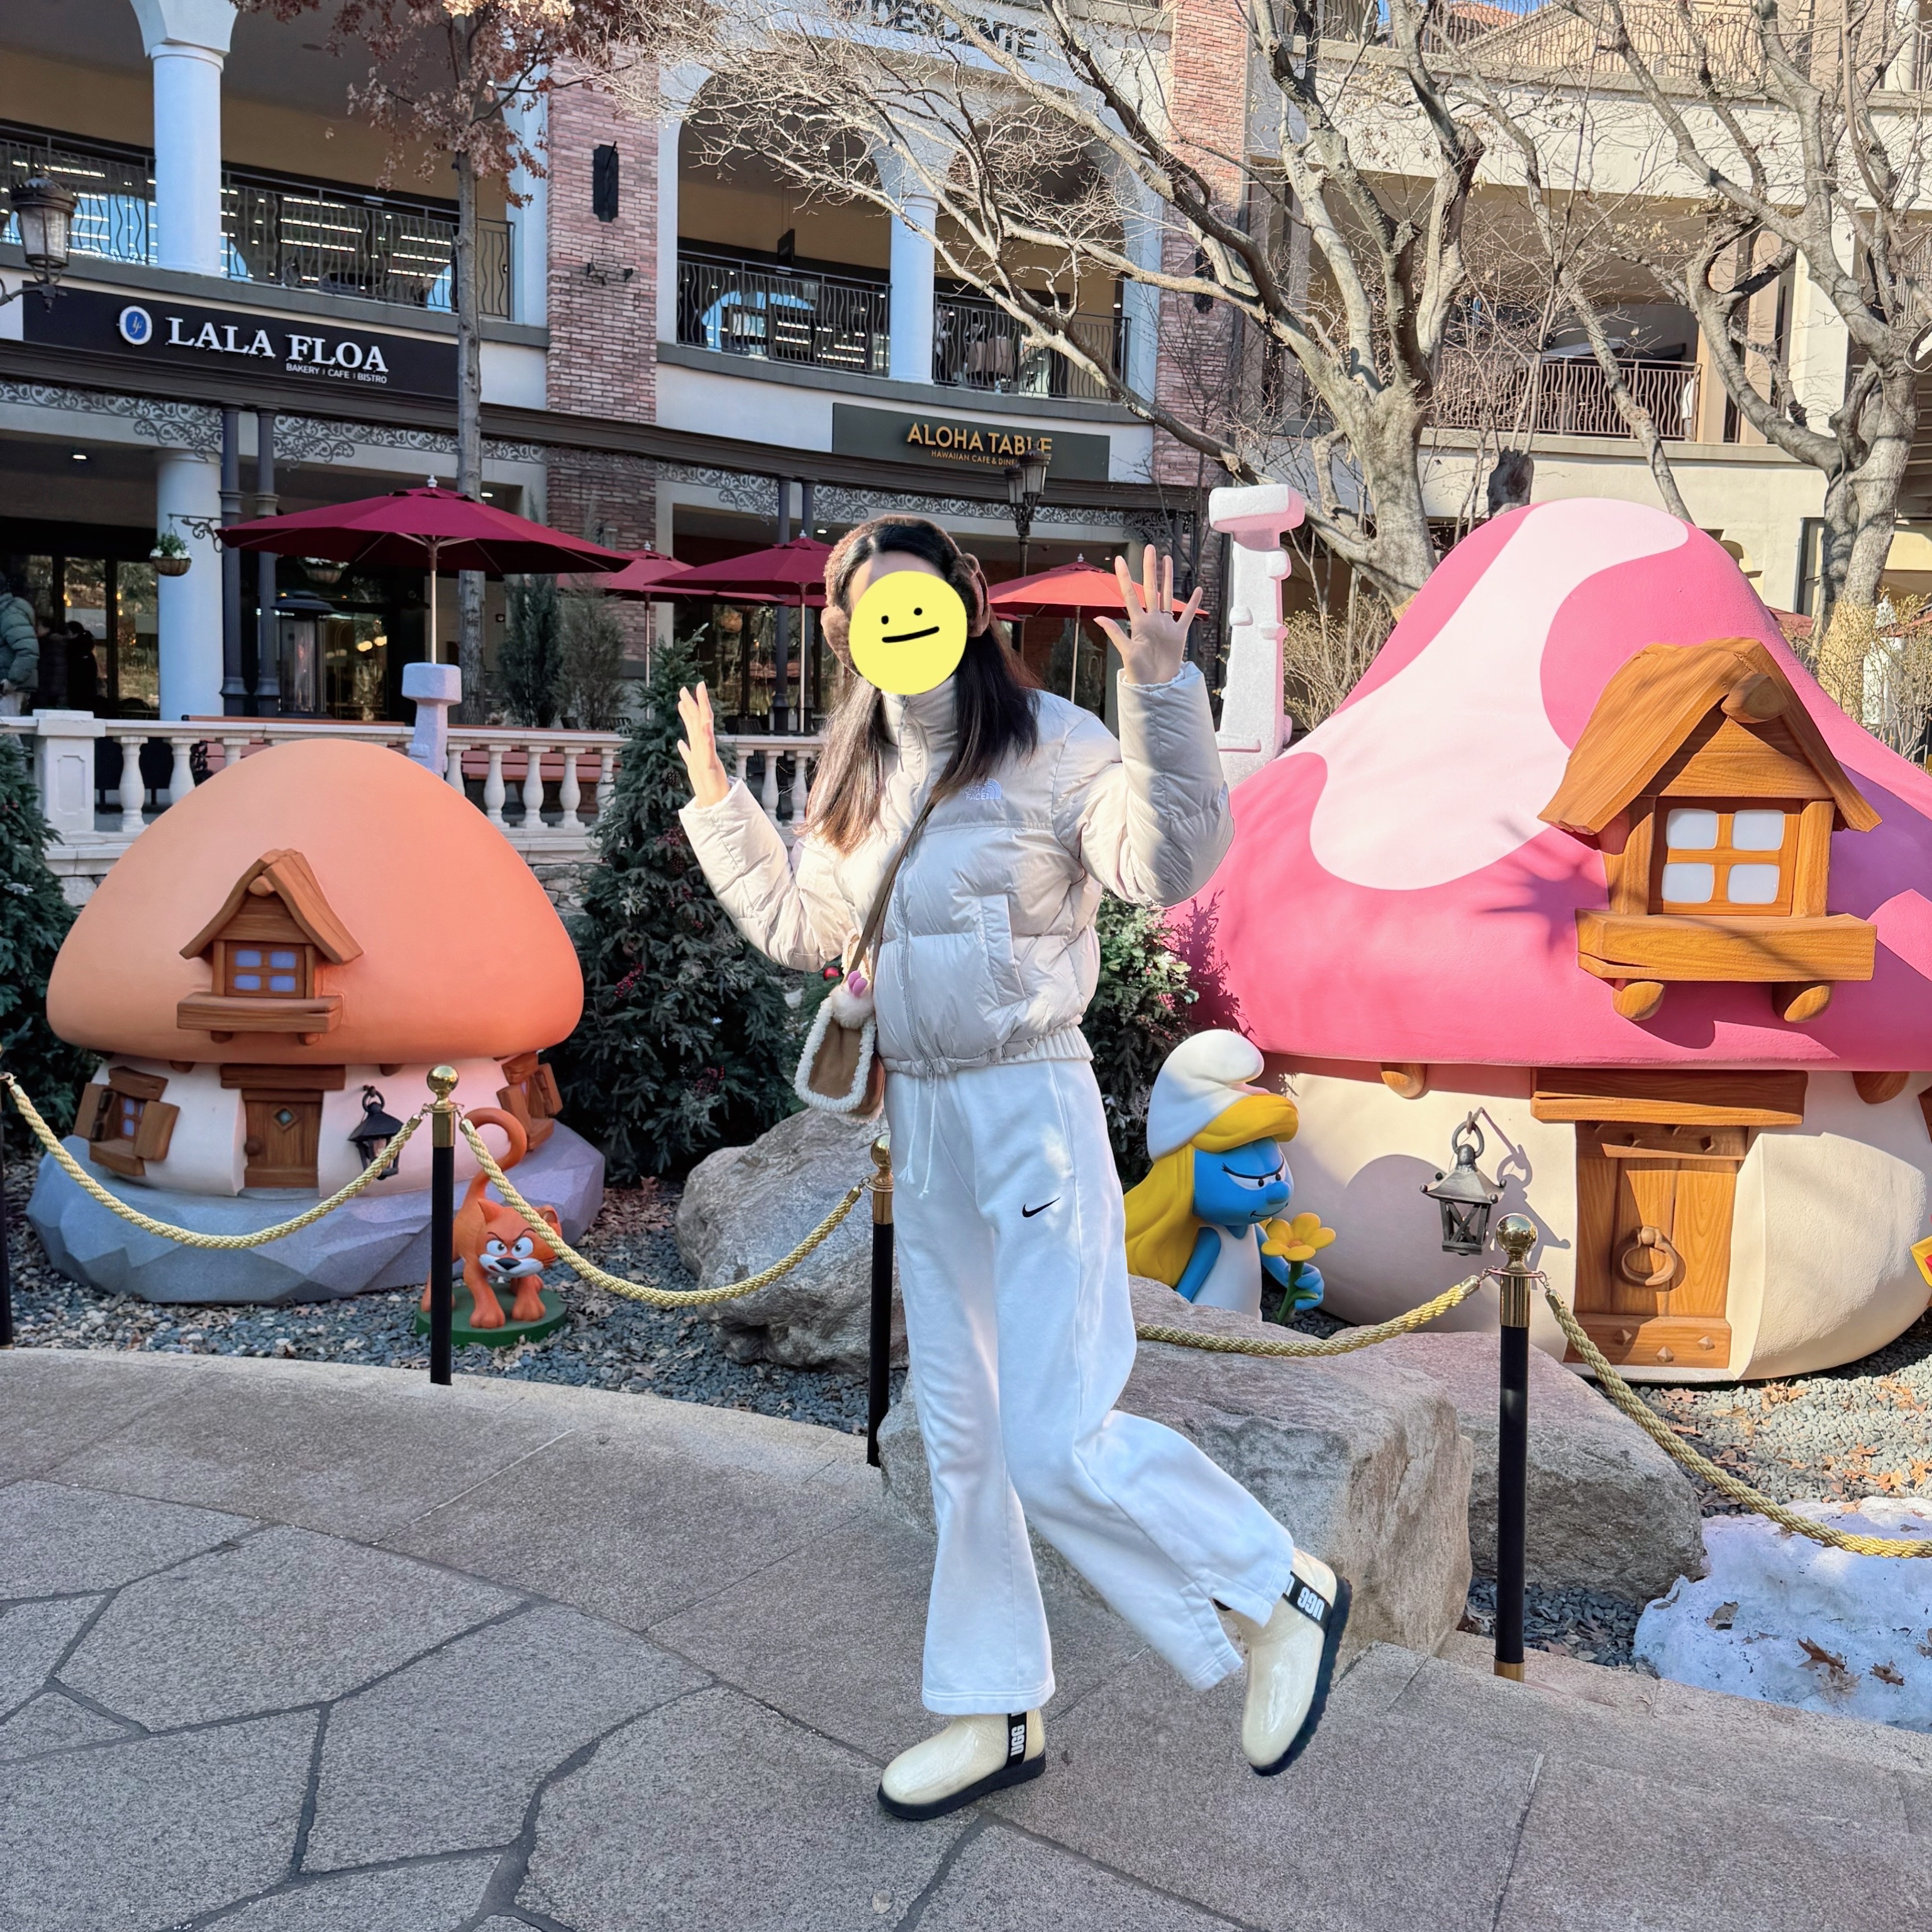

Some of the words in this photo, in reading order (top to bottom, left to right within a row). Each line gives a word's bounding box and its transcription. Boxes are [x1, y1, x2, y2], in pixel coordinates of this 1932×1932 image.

[166, 317, 275, 358] LALA
[286, 334, 390, 373] FLOA
[286, 363, 320, 375] BAKERY
[327, 369, 350, 379] CAFE
[357, 372, 387, 384] BISTRO
[906, 423, 984, 452] ALOHA
[931, 450, 970, 462] HAWAIIAN
[972, 455, 990, 464] CAFE
[991, 457, 997, 465] &
[965, 792, 986, 801] FACE
[1297, 1587, 1325, 1621] UGG
[1010, 1724, 1025, 1757] UGG
